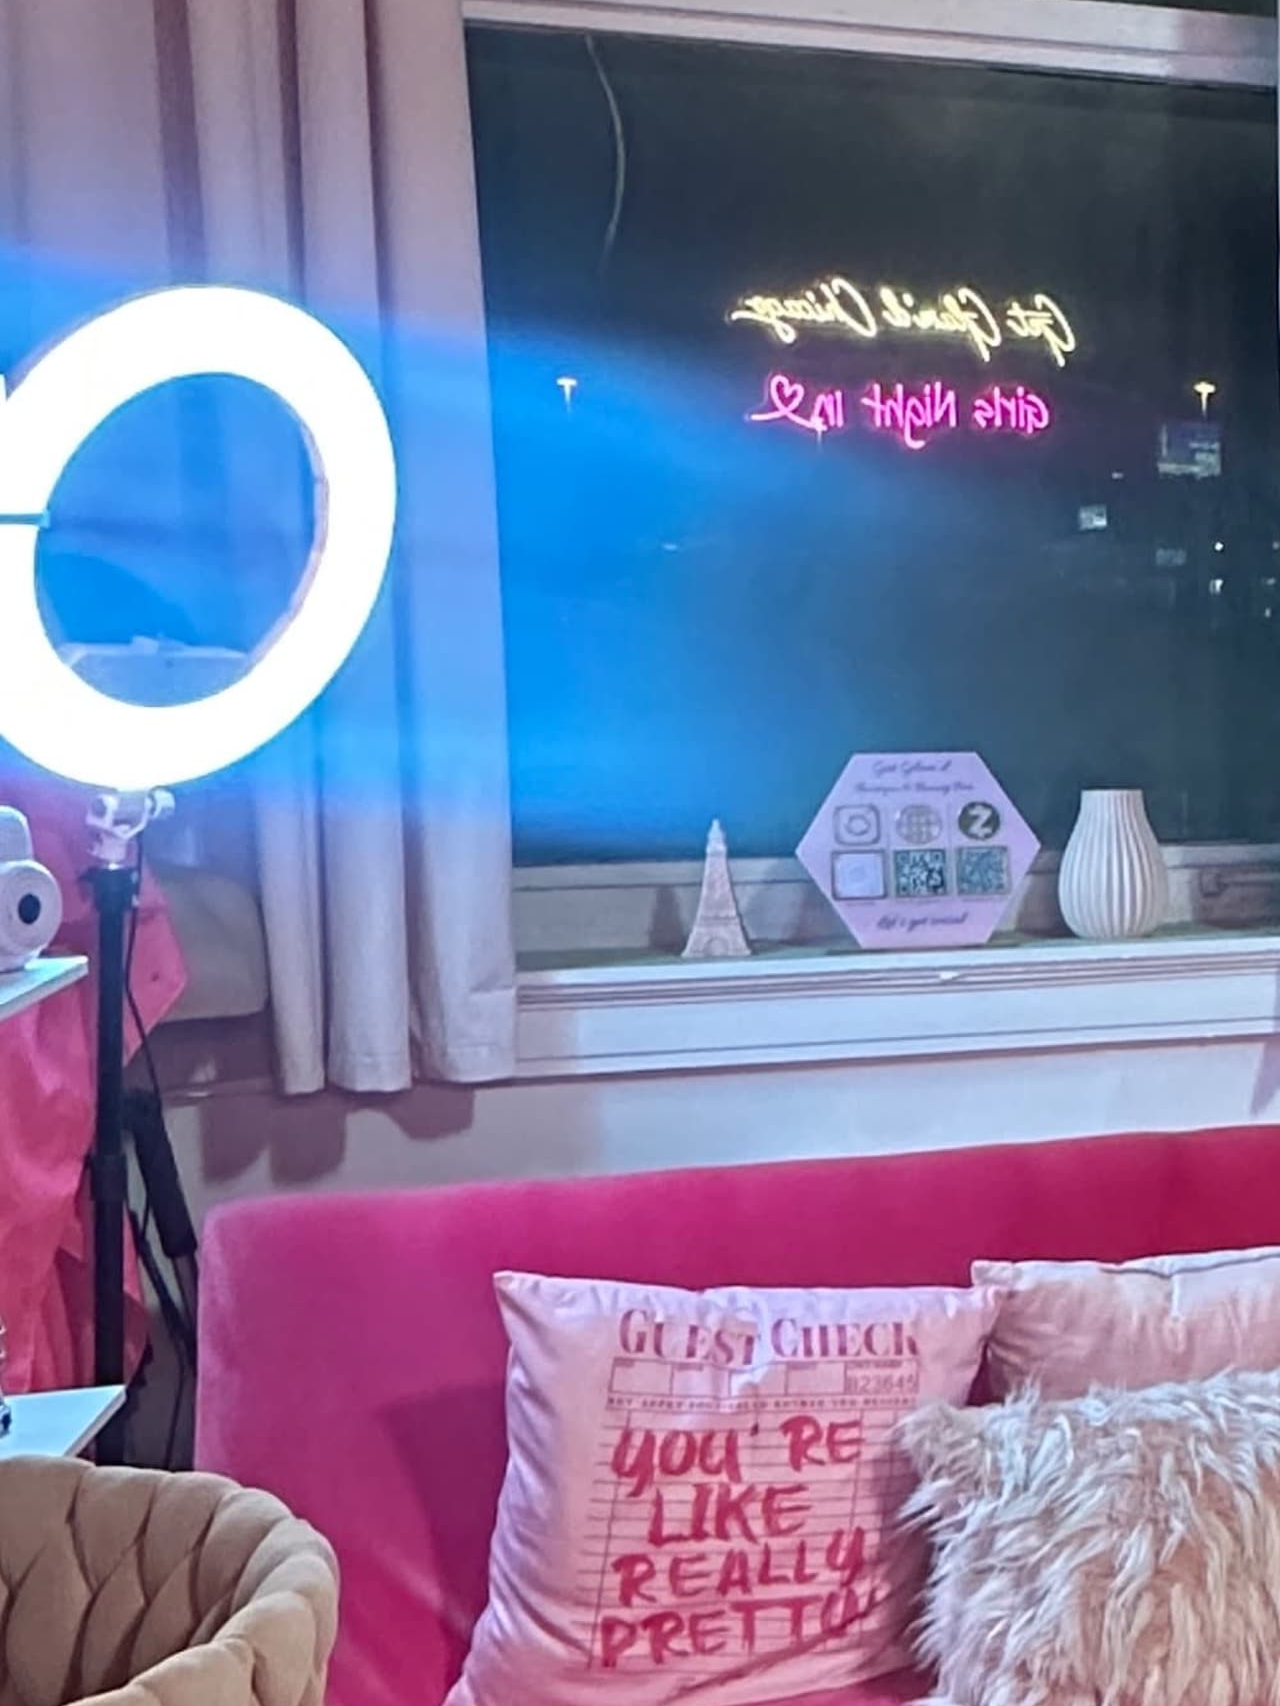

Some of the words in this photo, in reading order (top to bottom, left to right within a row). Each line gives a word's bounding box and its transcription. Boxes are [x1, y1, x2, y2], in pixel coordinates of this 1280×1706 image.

[619, 1308, 760, 1366] GUEST
[770, 1317, 919, 1358] CHECK
[647, 1483, 813, 1548] LIKE
[610, 1526, 866, 1607] REALLY
[600, 1586, 880, 1668] PRETTY
